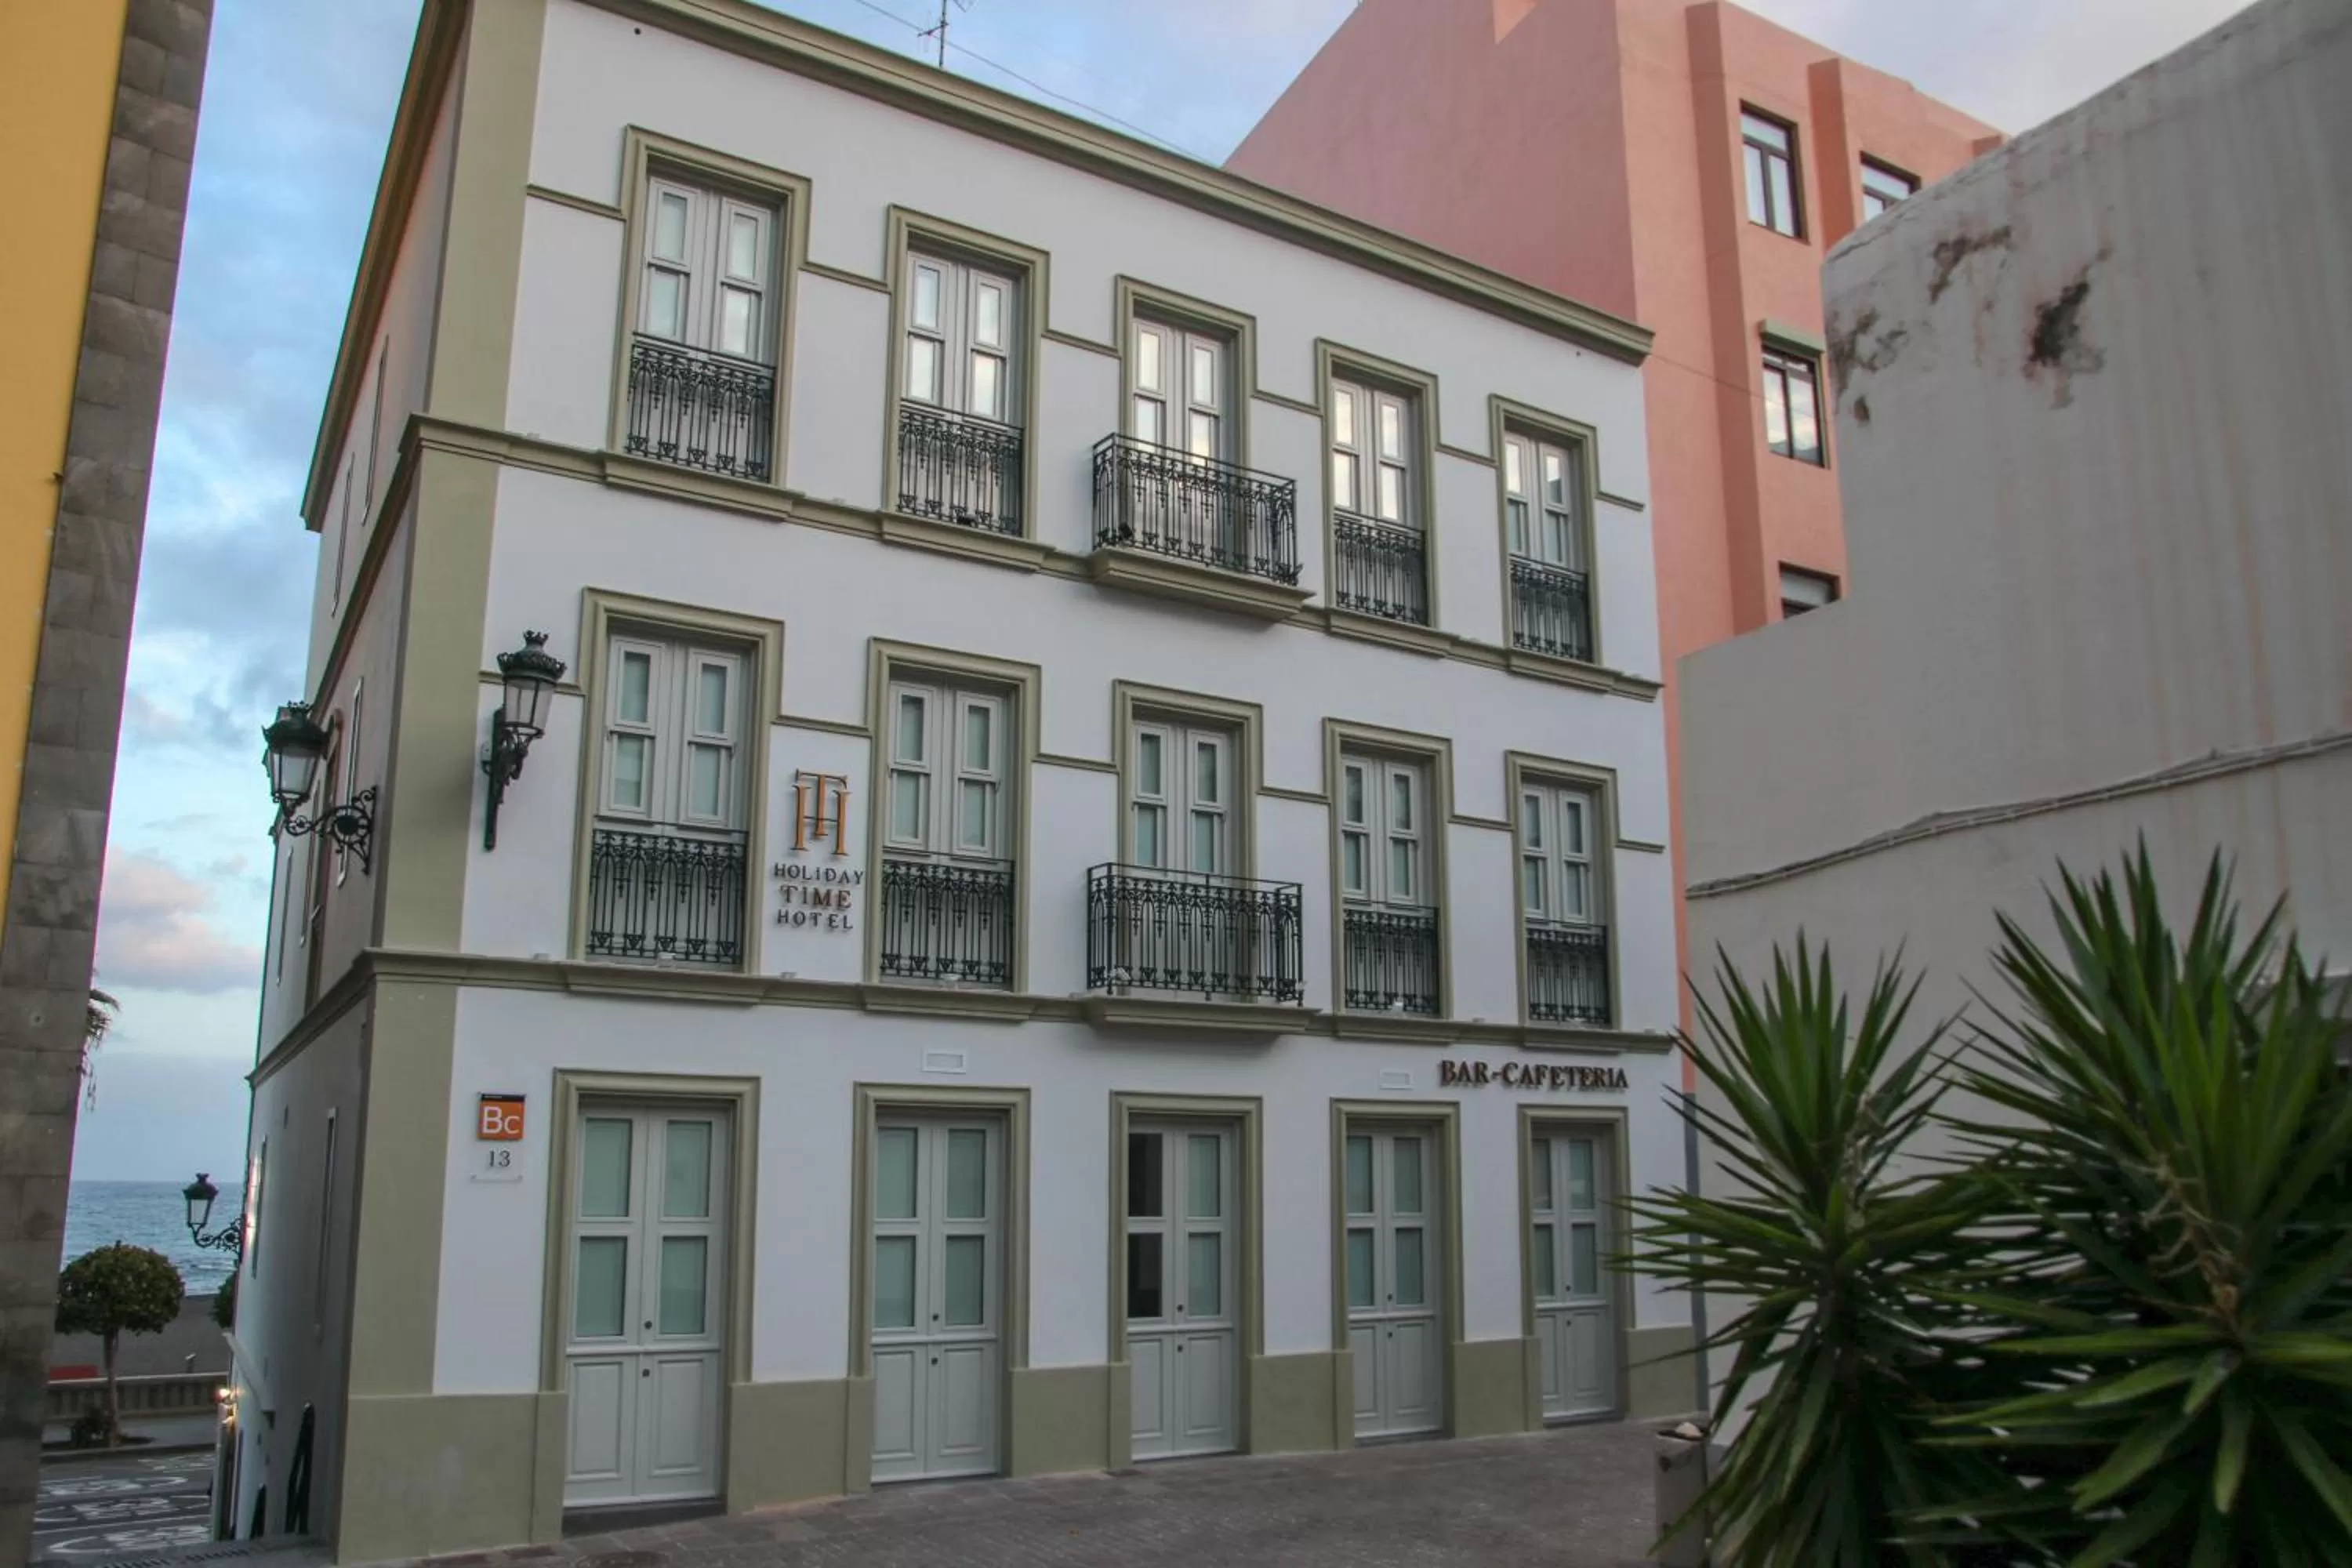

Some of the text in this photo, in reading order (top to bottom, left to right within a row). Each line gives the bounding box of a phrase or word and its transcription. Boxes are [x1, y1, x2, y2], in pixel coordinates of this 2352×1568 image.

[774, 862, 864, 884] HOLIDAY
[779, 885, 852, 909] TIME
[777, 909, 854, 929] HOTEL
[1440, 1060, 1629, 1089] BAR-CAFETERIA
[489, 1149, 511, 1167] 13
